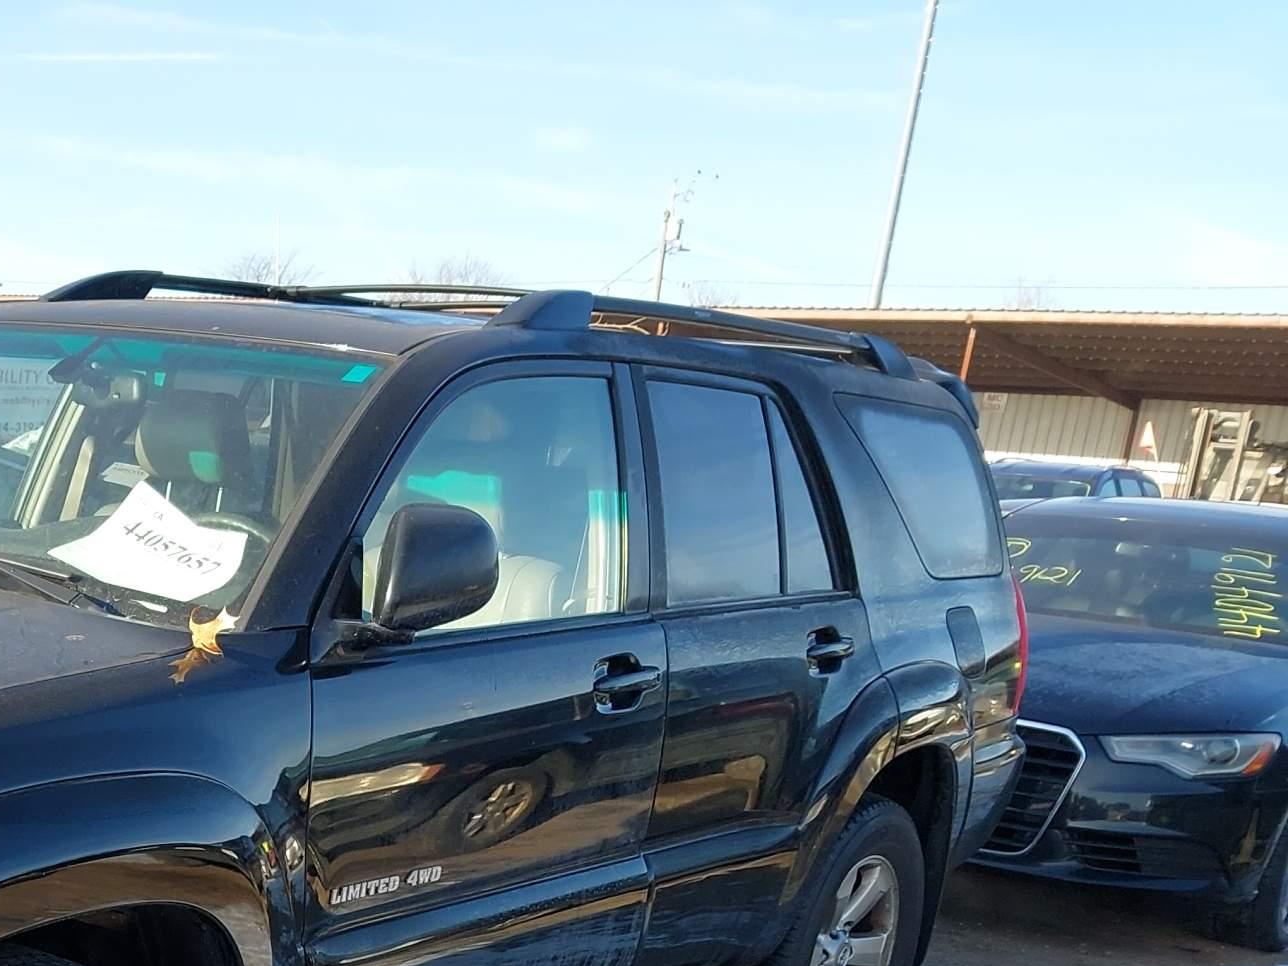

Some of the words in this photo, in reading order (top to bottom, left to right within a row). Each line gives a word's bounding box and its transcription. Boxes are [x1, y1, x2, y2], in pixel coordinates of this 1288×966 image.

[122, 521, 223, 575] 44057657
[331, 875, 400, 905] LIMITED
[406, 865, 442, 887] 4WD
